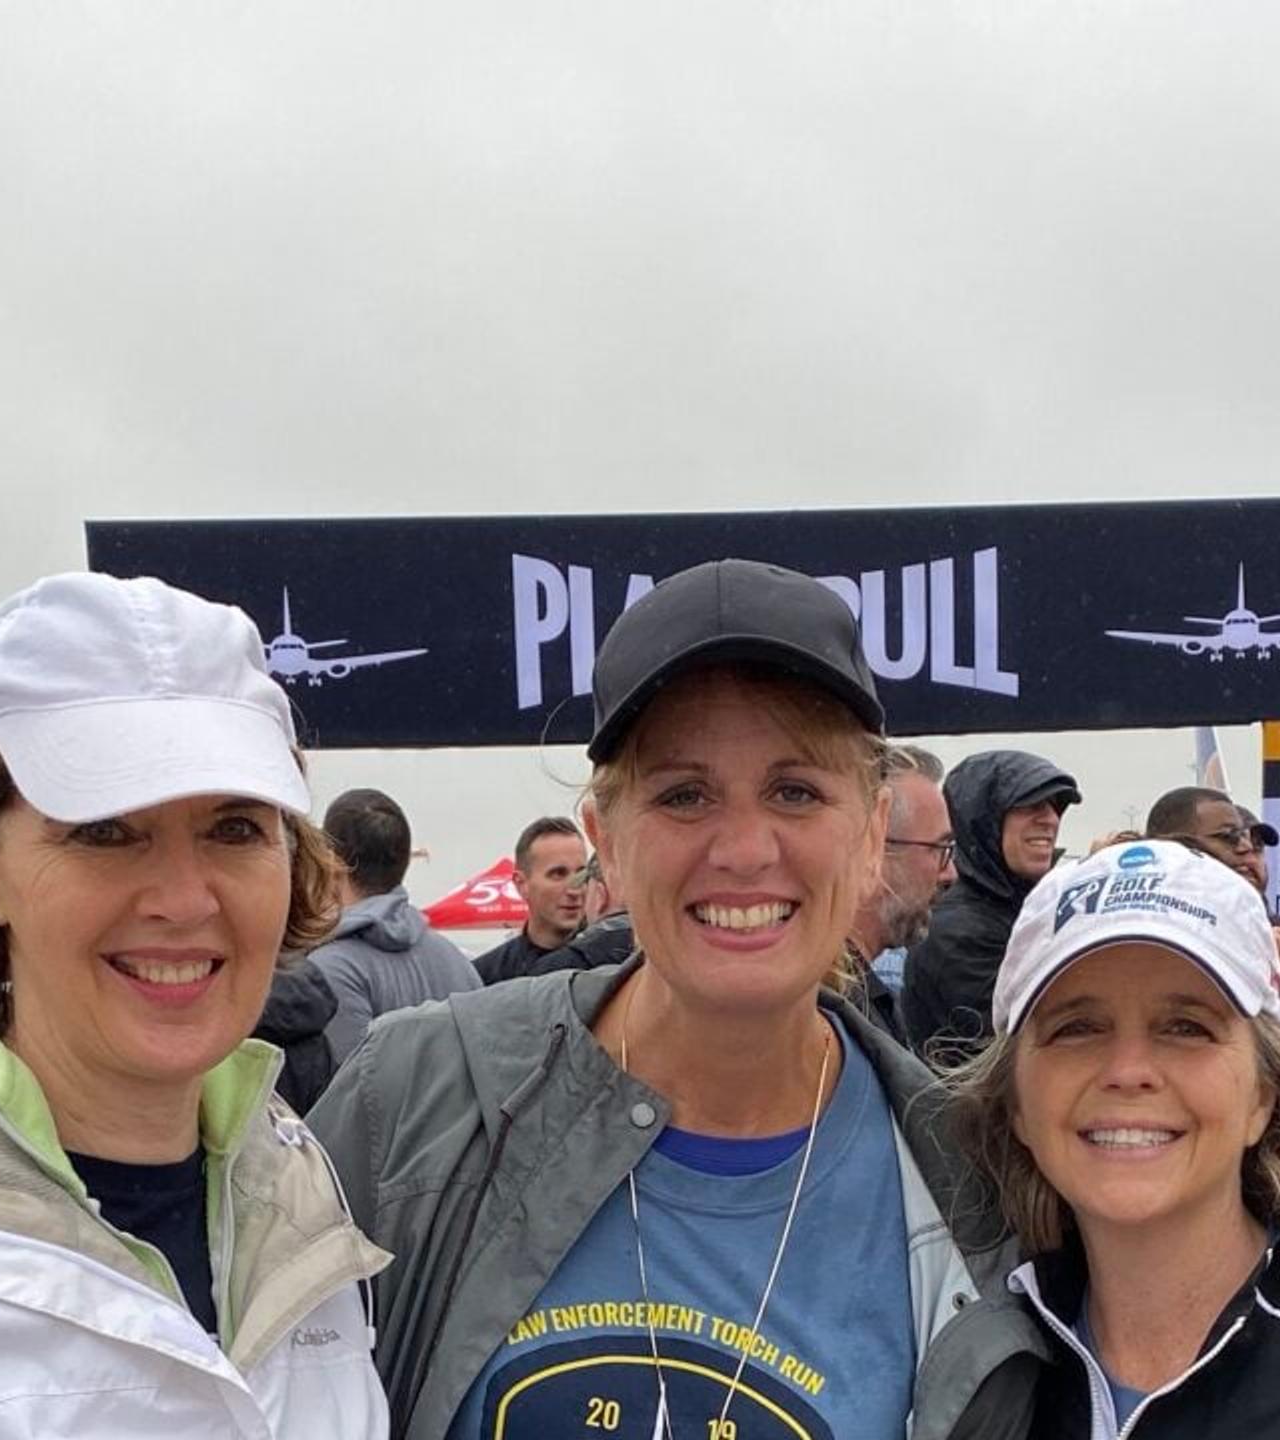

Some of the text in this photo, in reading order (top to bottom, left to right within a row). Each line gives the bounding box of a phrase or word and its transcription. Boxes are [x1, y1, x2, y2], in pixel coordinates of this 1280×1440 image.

[816, 546, 1019, 697] ULL
[1108, 876, 1166, 896] GOLF
[1104, 889, 1217, 927] CHAMPIONSHIPS
[506, 1301, 827, 1396] LAW ENFORCEMENT TORCH RUN
[585, 1397, 621, 1431] 20
